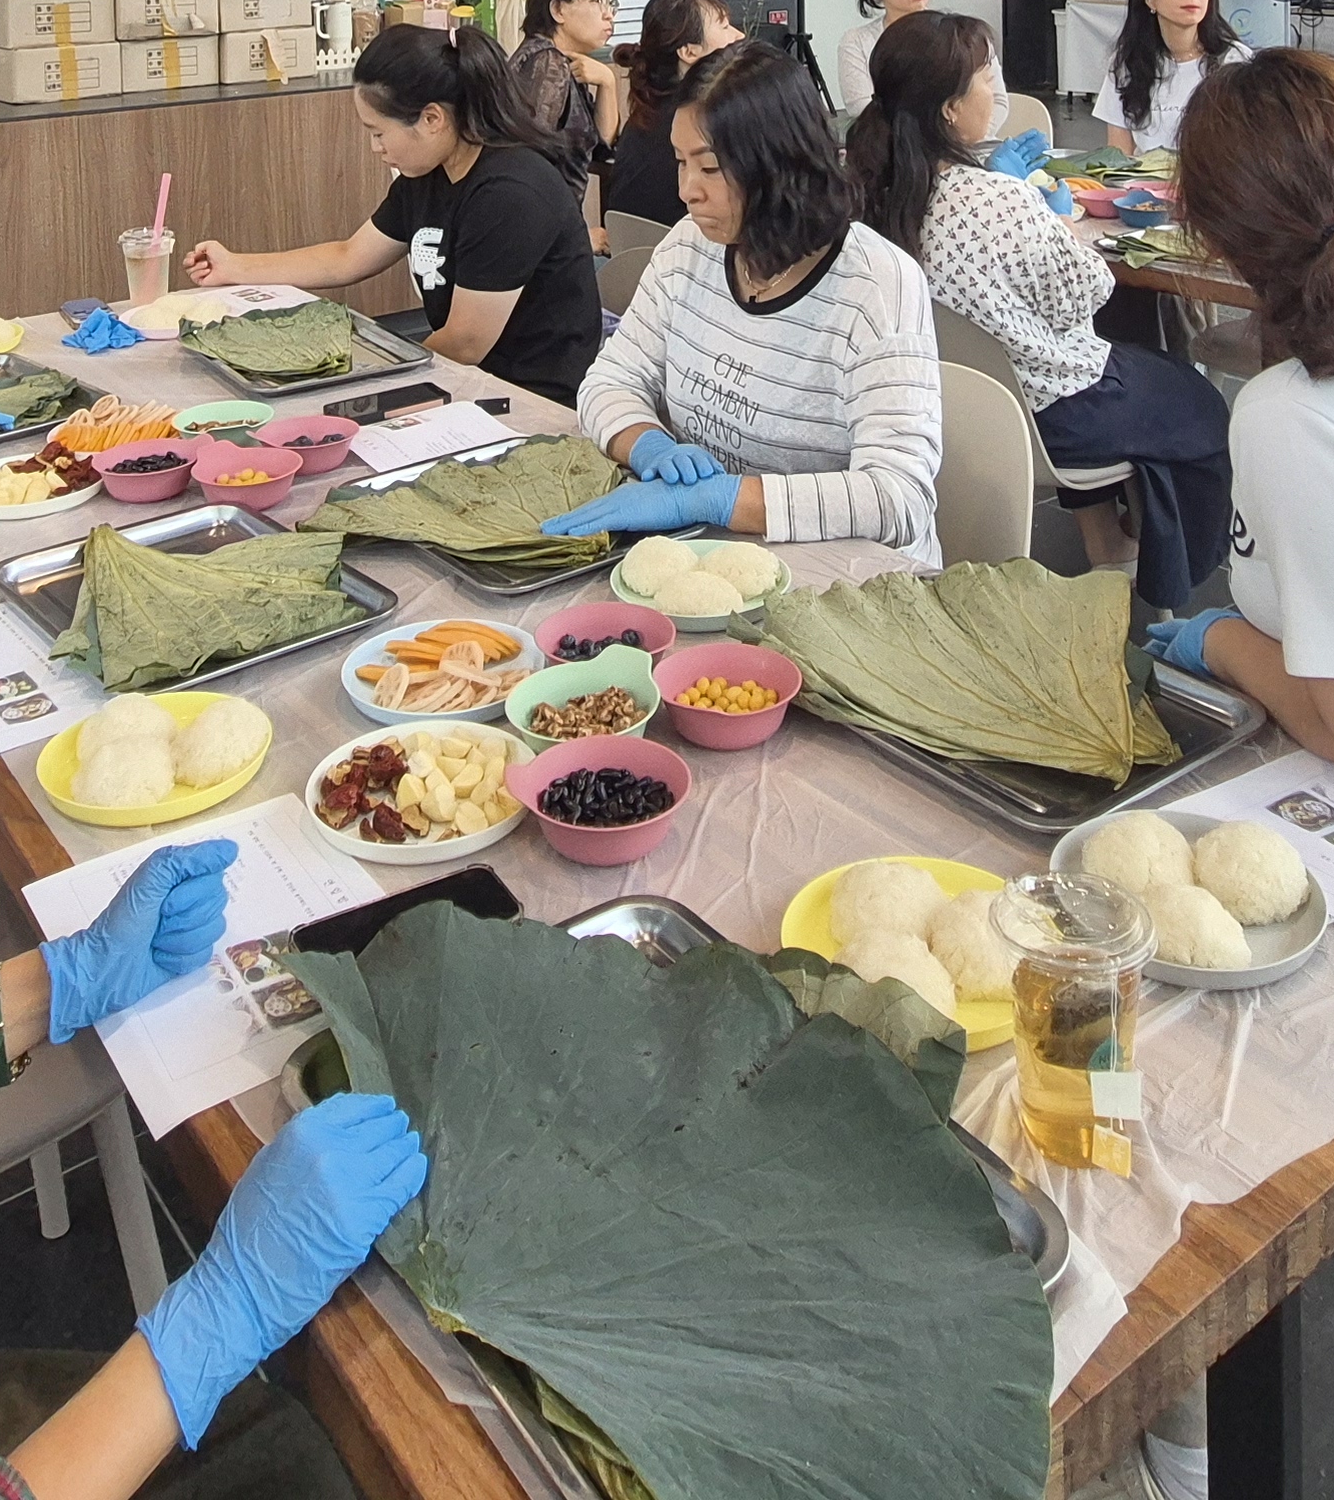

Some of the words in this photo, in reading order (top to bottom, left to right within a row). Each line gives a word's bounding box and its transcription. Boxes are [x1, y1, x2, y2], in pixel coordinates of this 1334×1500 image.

[713, 352, 754, 389] CHE
[690, 370, 760, 427] TOMBINI
[685, 404, 742, 450] SIANO
